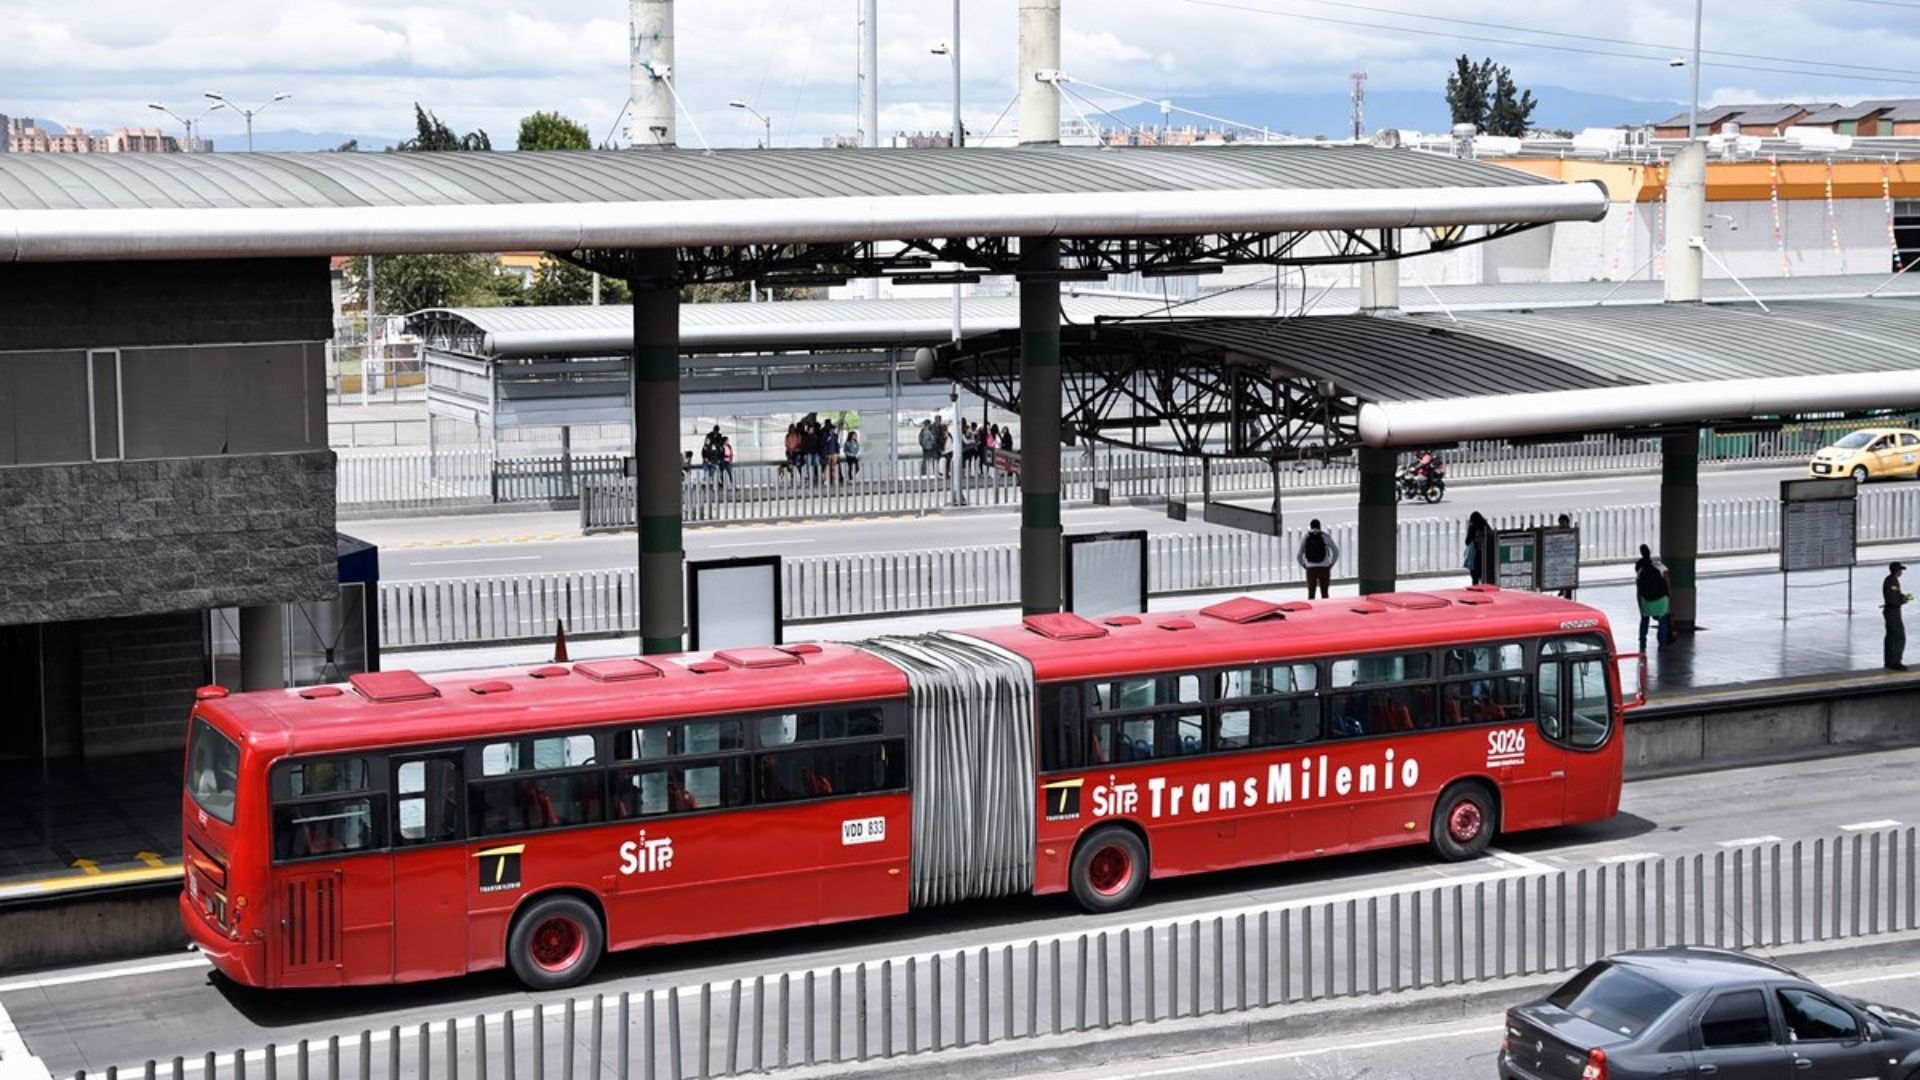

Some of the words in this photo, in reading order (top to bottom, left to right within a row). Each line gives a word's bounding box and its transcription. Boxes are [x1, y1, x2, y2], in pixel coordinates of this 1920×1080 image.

[1487, 728, 1526, 754] S026
[1148, 748, 1419, 818] TransMilenio
[844, 822, 863, 837] VDD
[868, 820, 884, 836] 833
